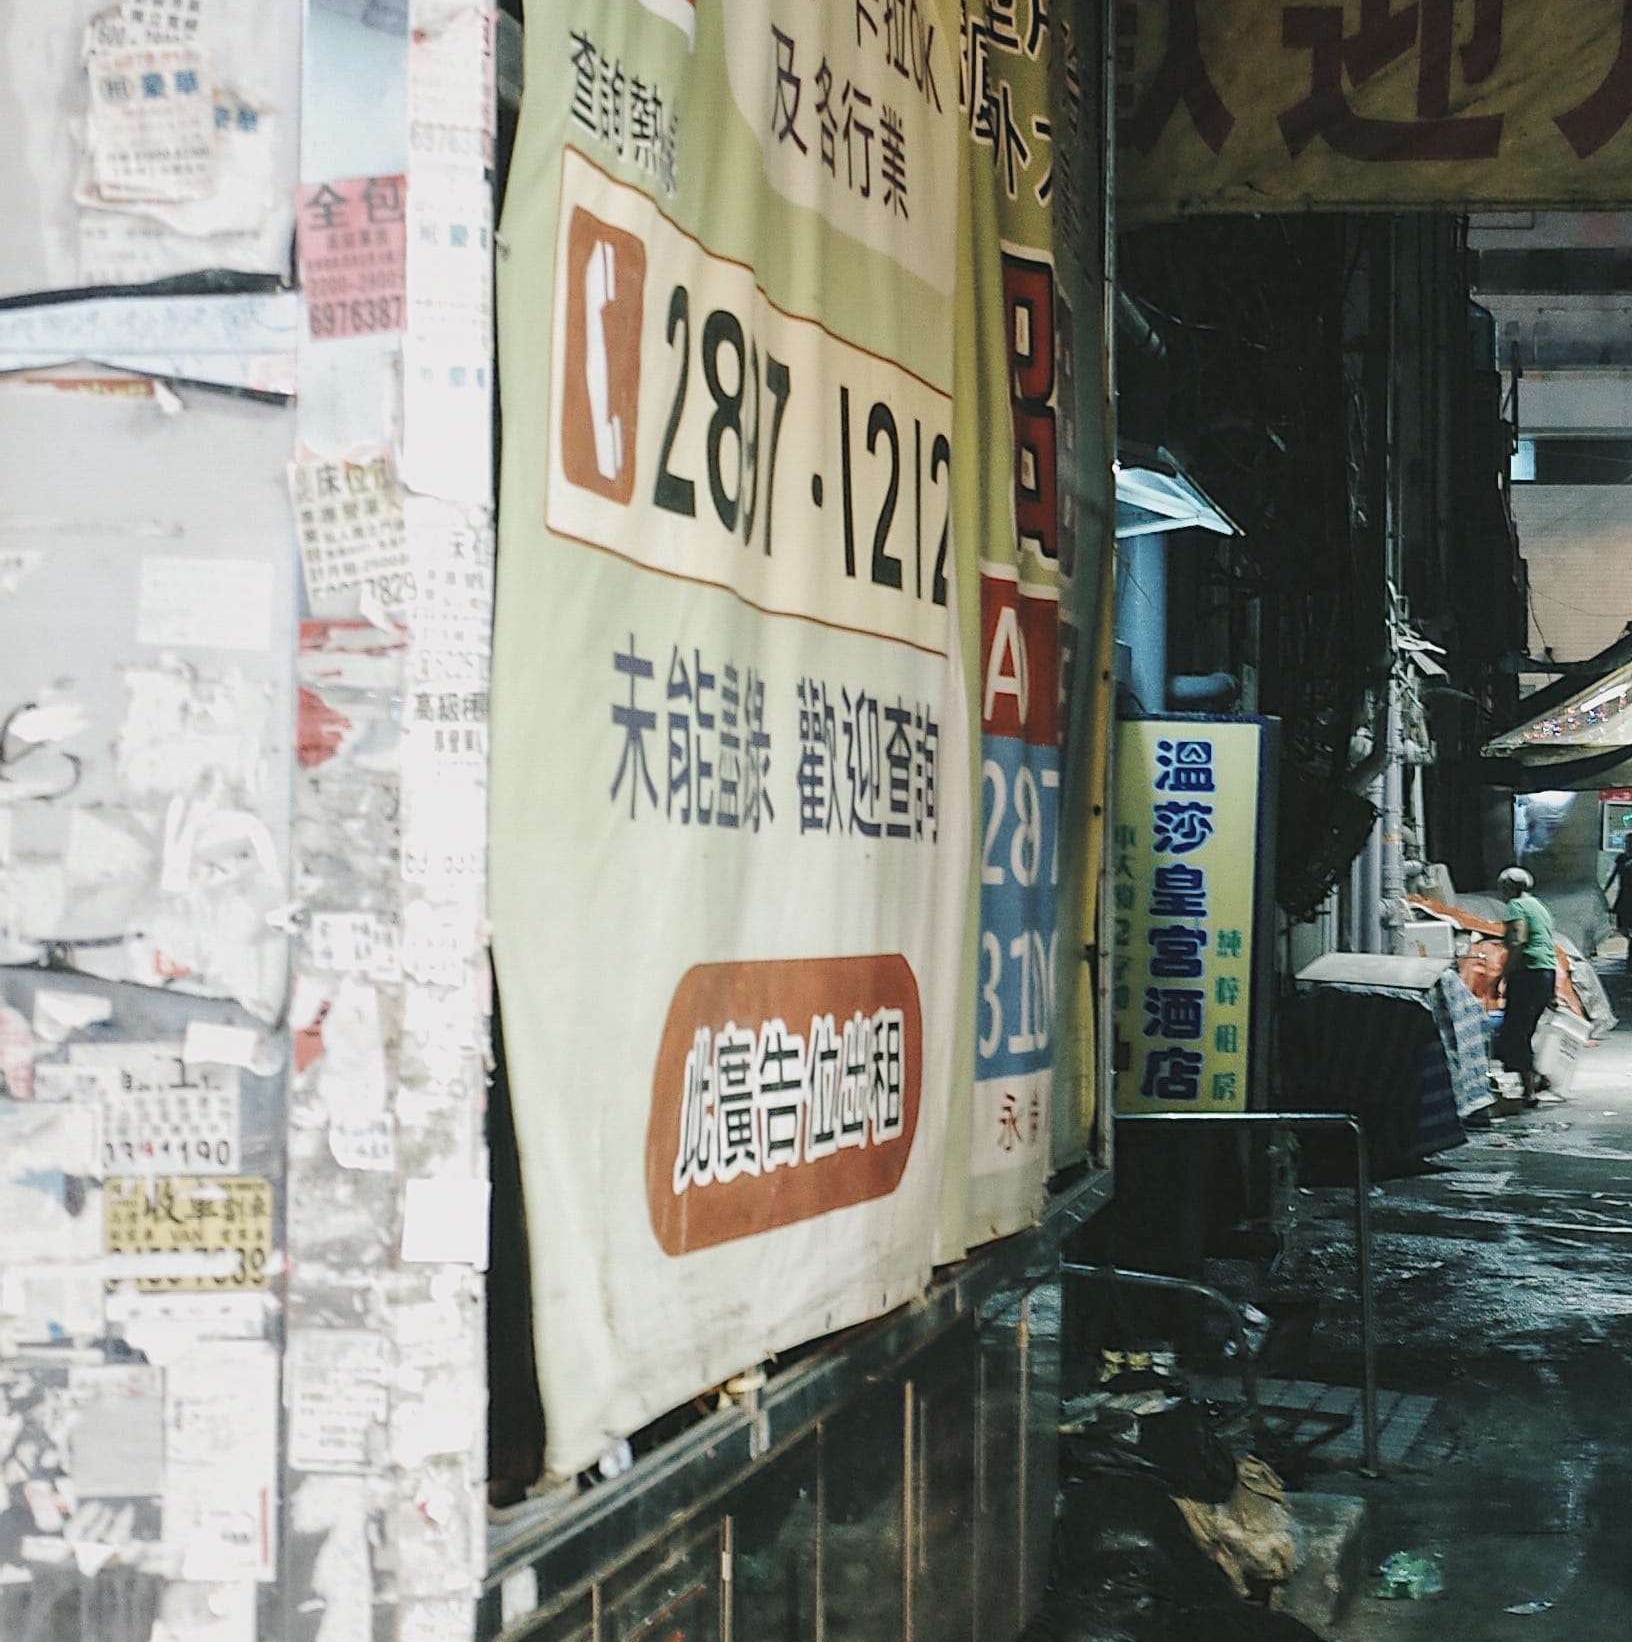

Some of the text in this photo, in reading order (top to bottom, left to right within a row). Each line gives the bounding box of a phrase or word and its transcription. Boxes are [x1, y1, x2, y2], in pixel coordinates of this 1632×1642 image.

[771, 24, 909, 221] 及各行業
[609, 631, 940, 847] 未能盡錄 歡迎查詢
